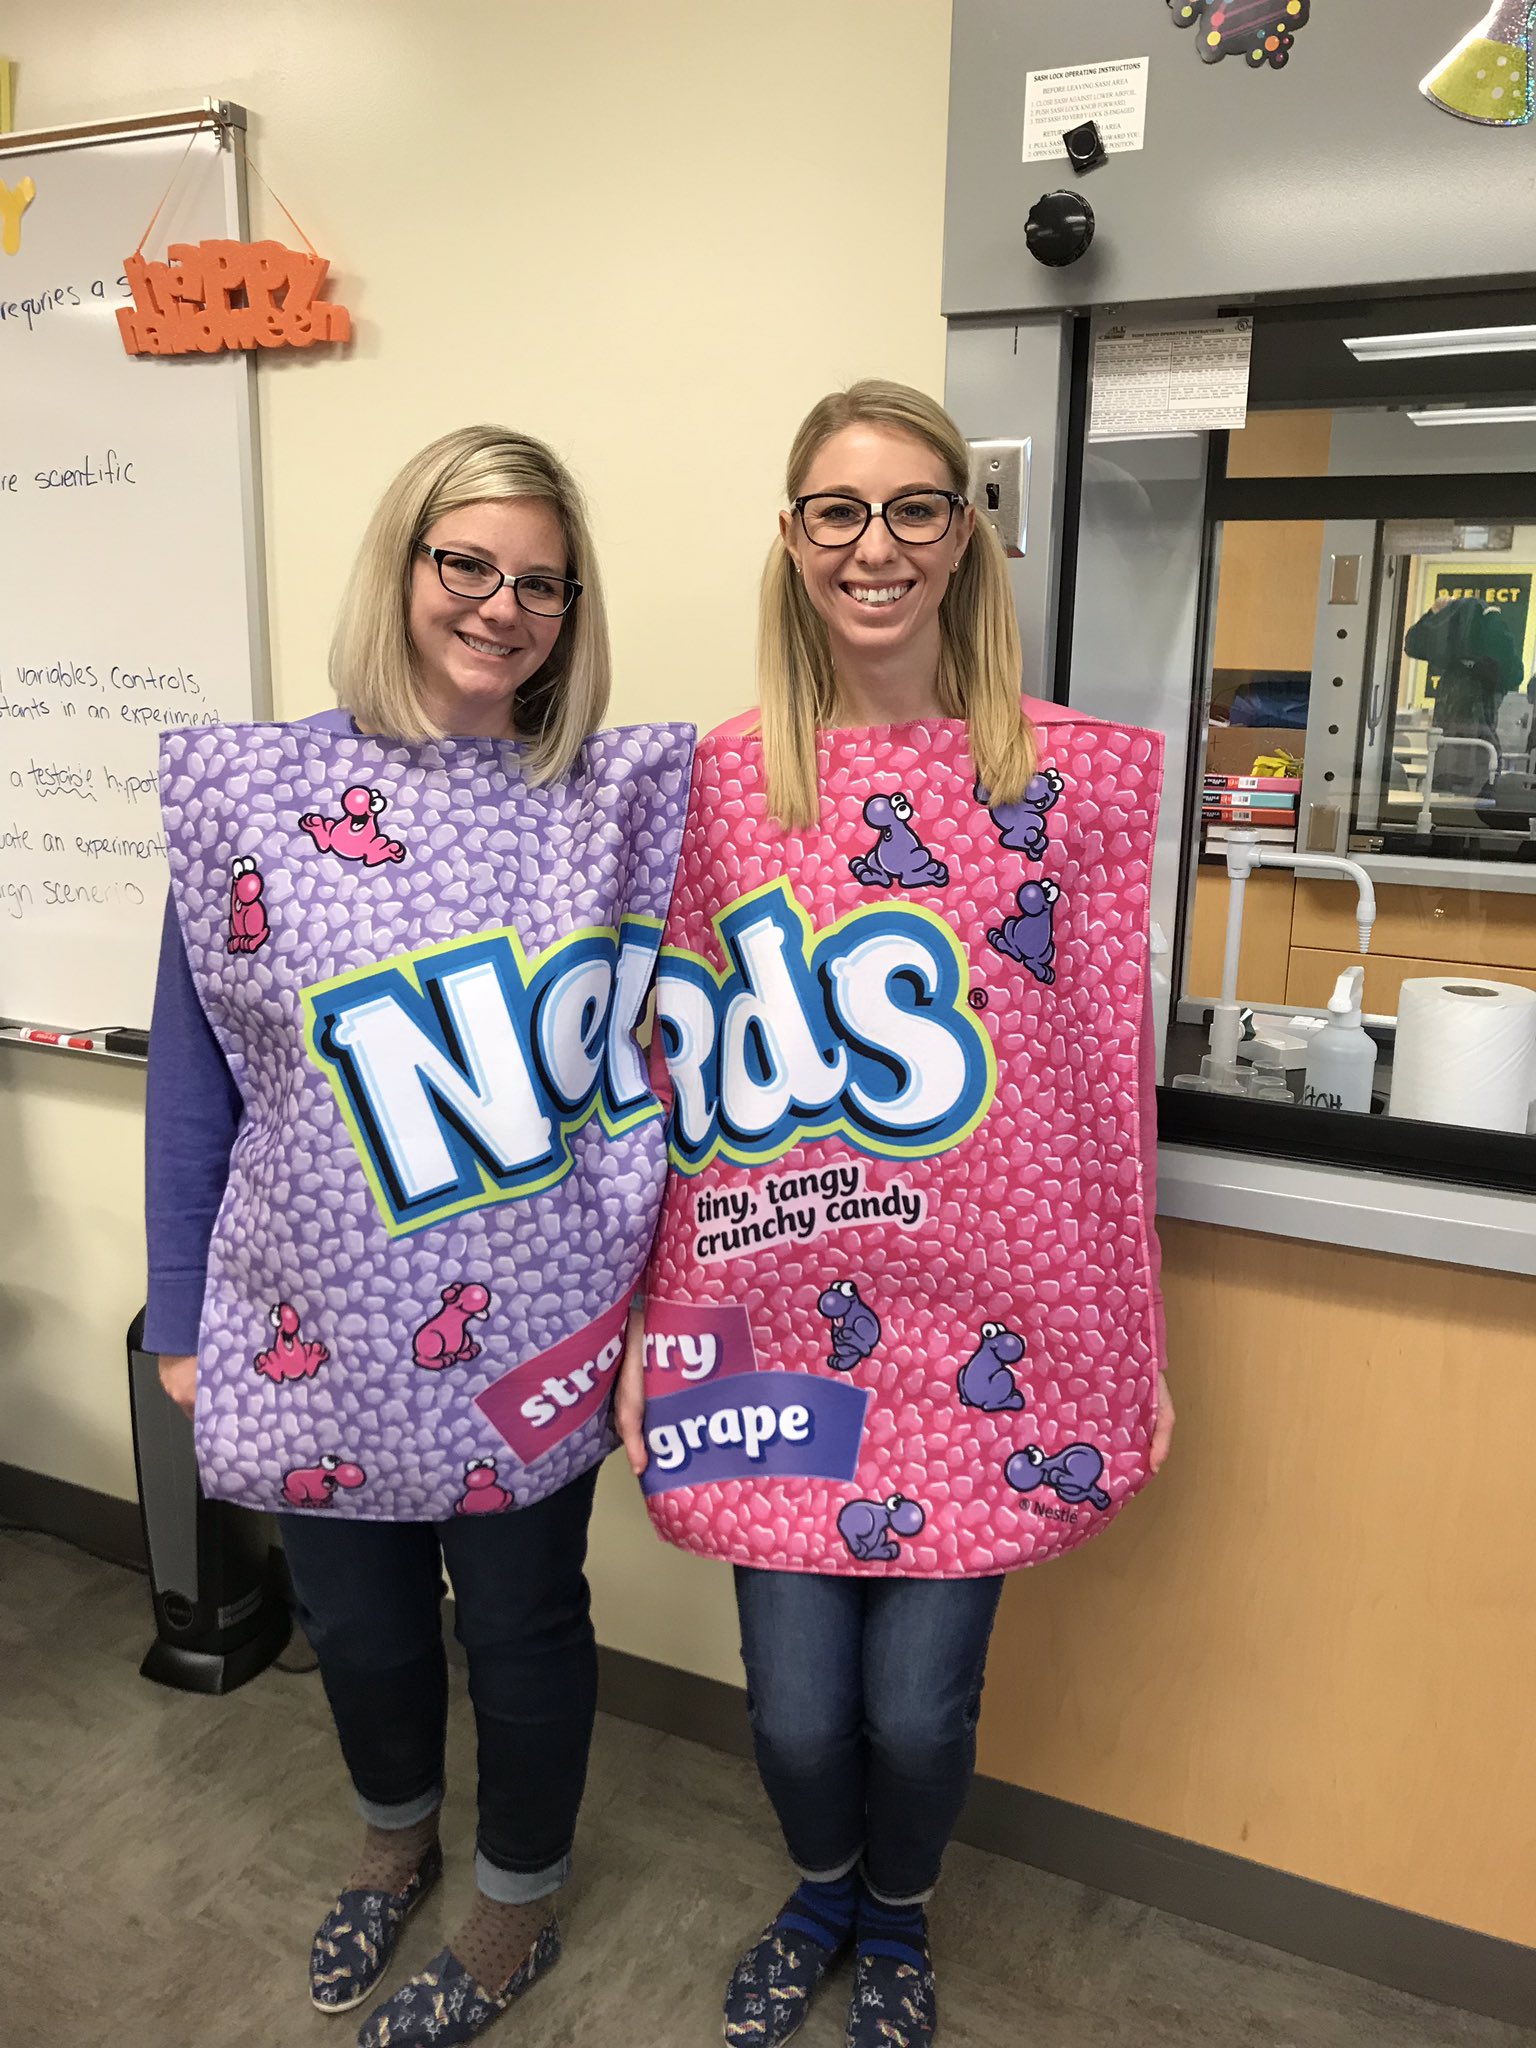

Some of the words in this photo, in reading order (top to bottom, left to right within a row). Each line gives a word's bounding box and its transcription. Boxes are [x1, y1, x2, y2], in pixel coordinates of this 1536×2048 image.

[1033, 73, 1048, 82] SASH
[1049, 71, 1064, 81] LOCK
[1065, 67, 1097, 78] OPERATING
[1098, 63, 1141, 74] INSTRUCTIONS
[1042, 85, 1066, 95] BEFORE
[1066, 82, 1094, 92] LEAVING
[1094, 80, 1111, 90] SASH
[1112, 78, 1128, 87] AREA
[1035, 99, 1053, 107] CLOSE
[1054, 97, 1068, 105] SASH
[1068, 94, 1093, 104] AGAINST
[1093, 92, 1114, 101] LOWER
[1035, 107, 1050, 116] PUSH
[1050, 106, 1065, 114] SASH
[1065, 104, 1080, 113] LOCK
[1081, 103, 1097, 111] KNOB
[1035, 117, 1047, 125] TEST
[1047, 115, 1061, 123] SASH
[1069, 112, 1088, 121] VERIFY
[1088, 110, 1103, 119] LOCK
[1105, 123, 1121, 131] AREA
[1033, 141, 1048, 149] PULL
[1033, 149, 1047, 158] OPEN
[1048, 147, 1063, 156] SASH
[90, 279, 107, 299] a
[35, 449, 136, 489] scientific
[60, 700, 76, 717] in
[88, 703, 110, 720] an
[10, 771, 23, 788] a
[43, 833, 65, 852] an
[76, 832, 167, 860] experiment
[333, 915, 968, 1198] Nerds
[696, 1191, 758, 1224] tiny,
[766, 1166, 859, 1204] tangy
[696, 1206, 816, 1258] crunchy
[826, 1185, 921, 1225] candy
[648, 1404, 810, 1470] grape
